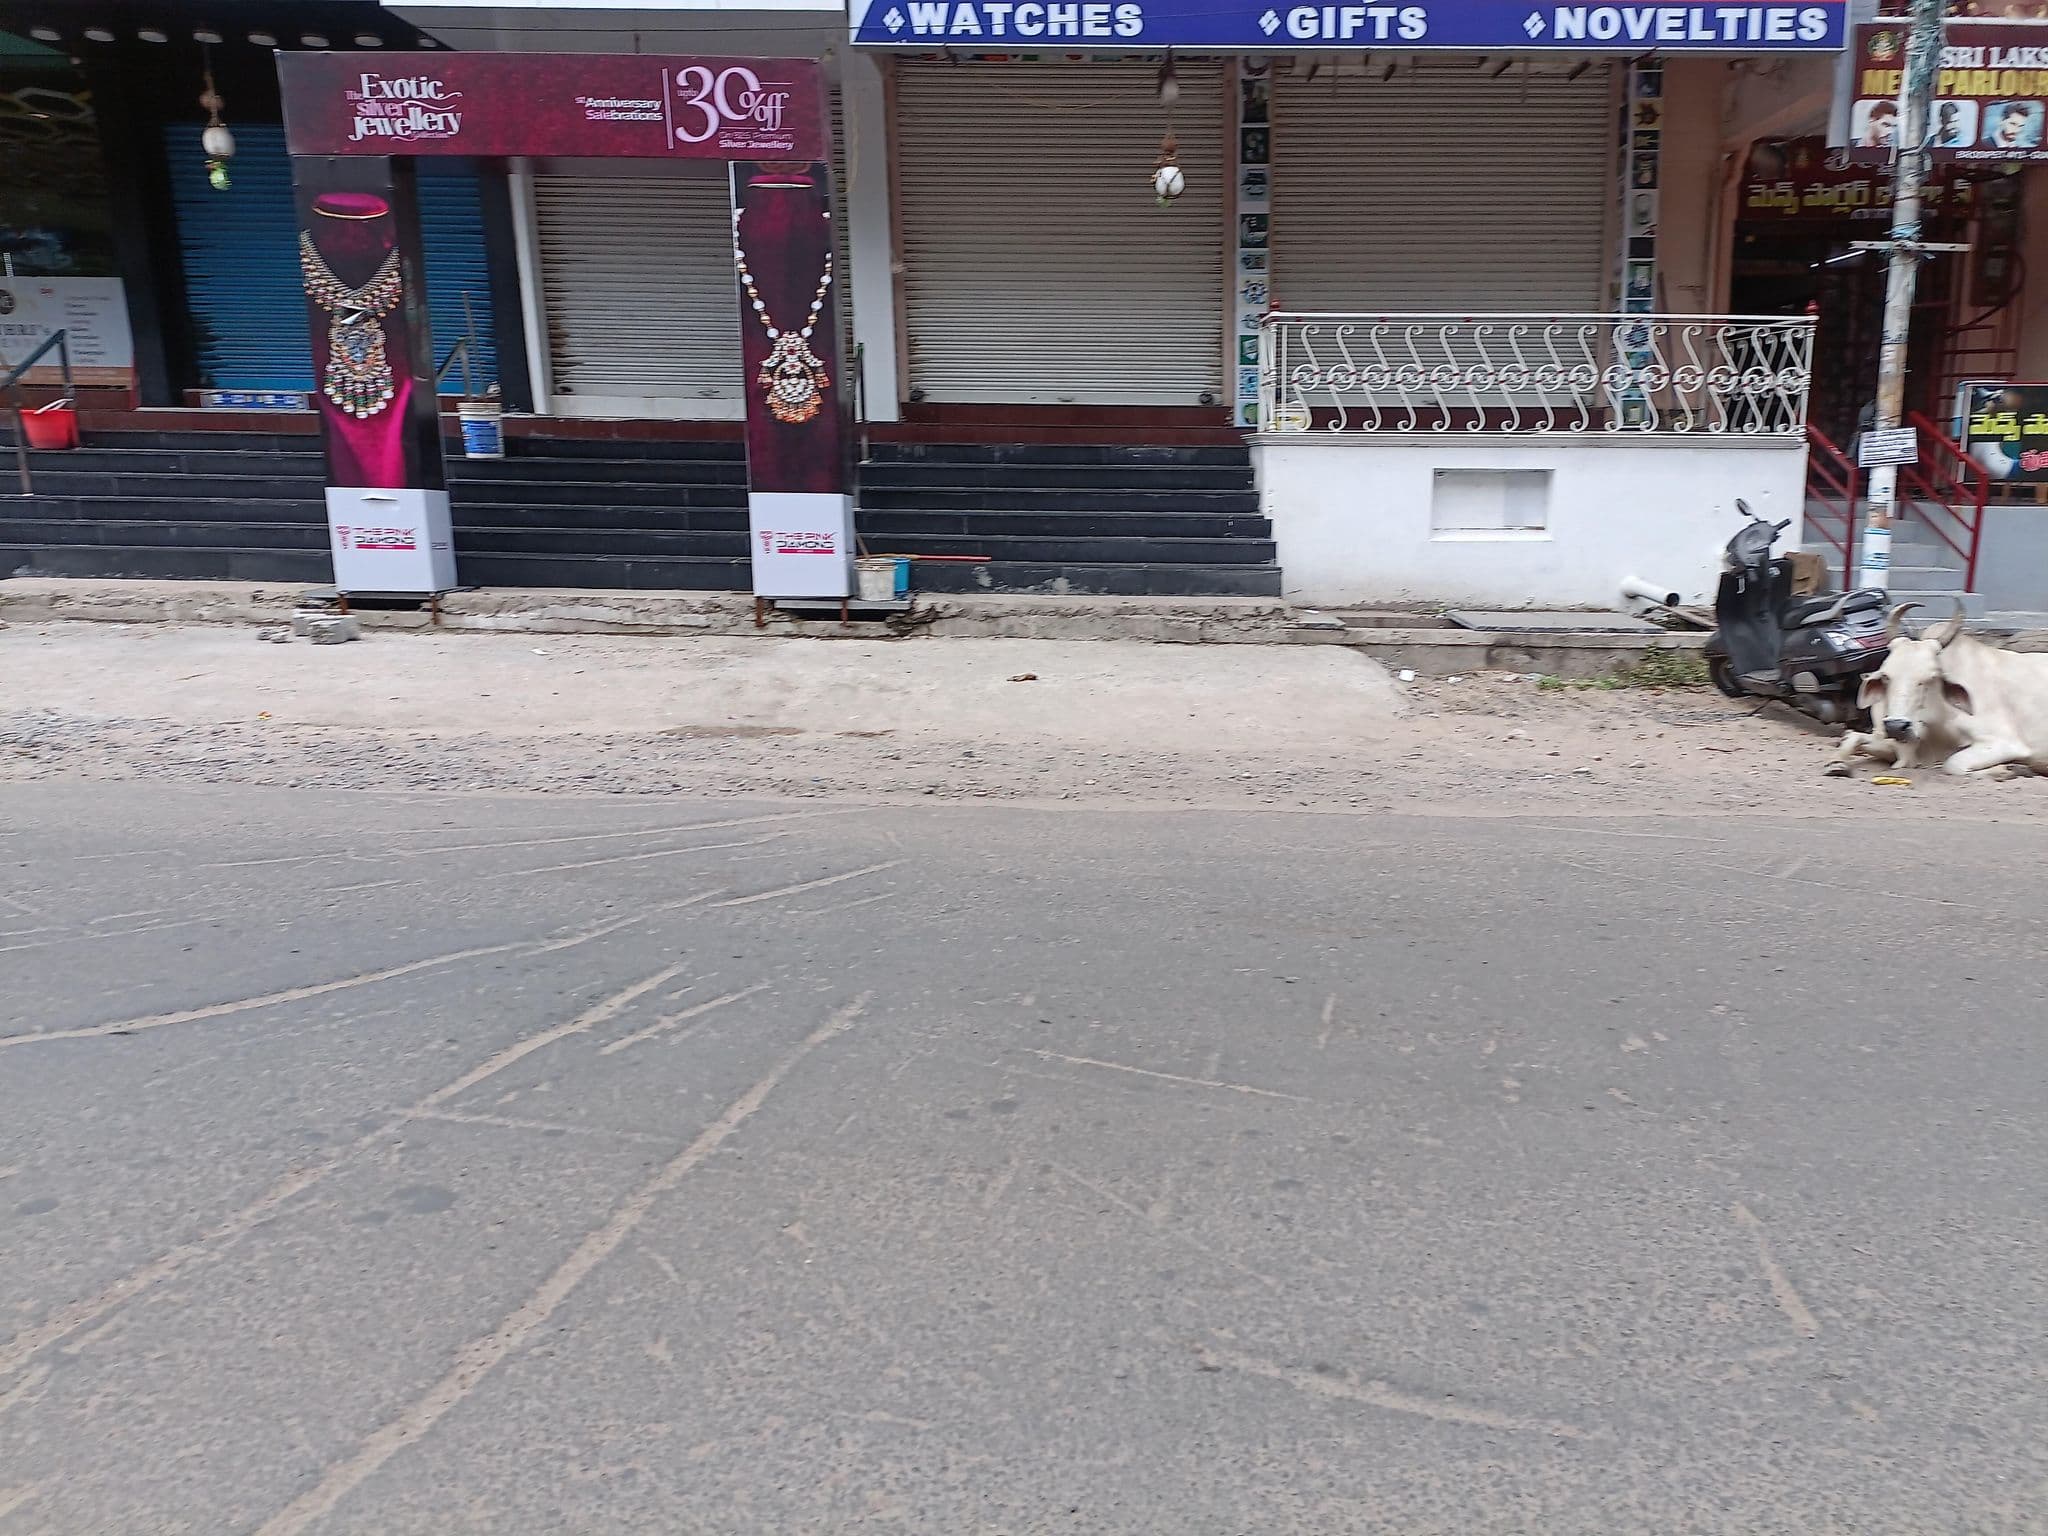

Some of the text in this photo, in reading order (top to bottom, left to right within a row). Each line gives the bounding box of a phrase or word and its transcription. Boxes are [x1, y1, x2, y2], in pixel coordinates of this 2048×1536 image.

[908, 3, 1828, 41] WATCHES GIFTS NOVELTIES
[1939, 46, 1985, 68] SRI
[360, 73, 445, 100] Exotic
[585, 97, 662, 111] Anniversary
